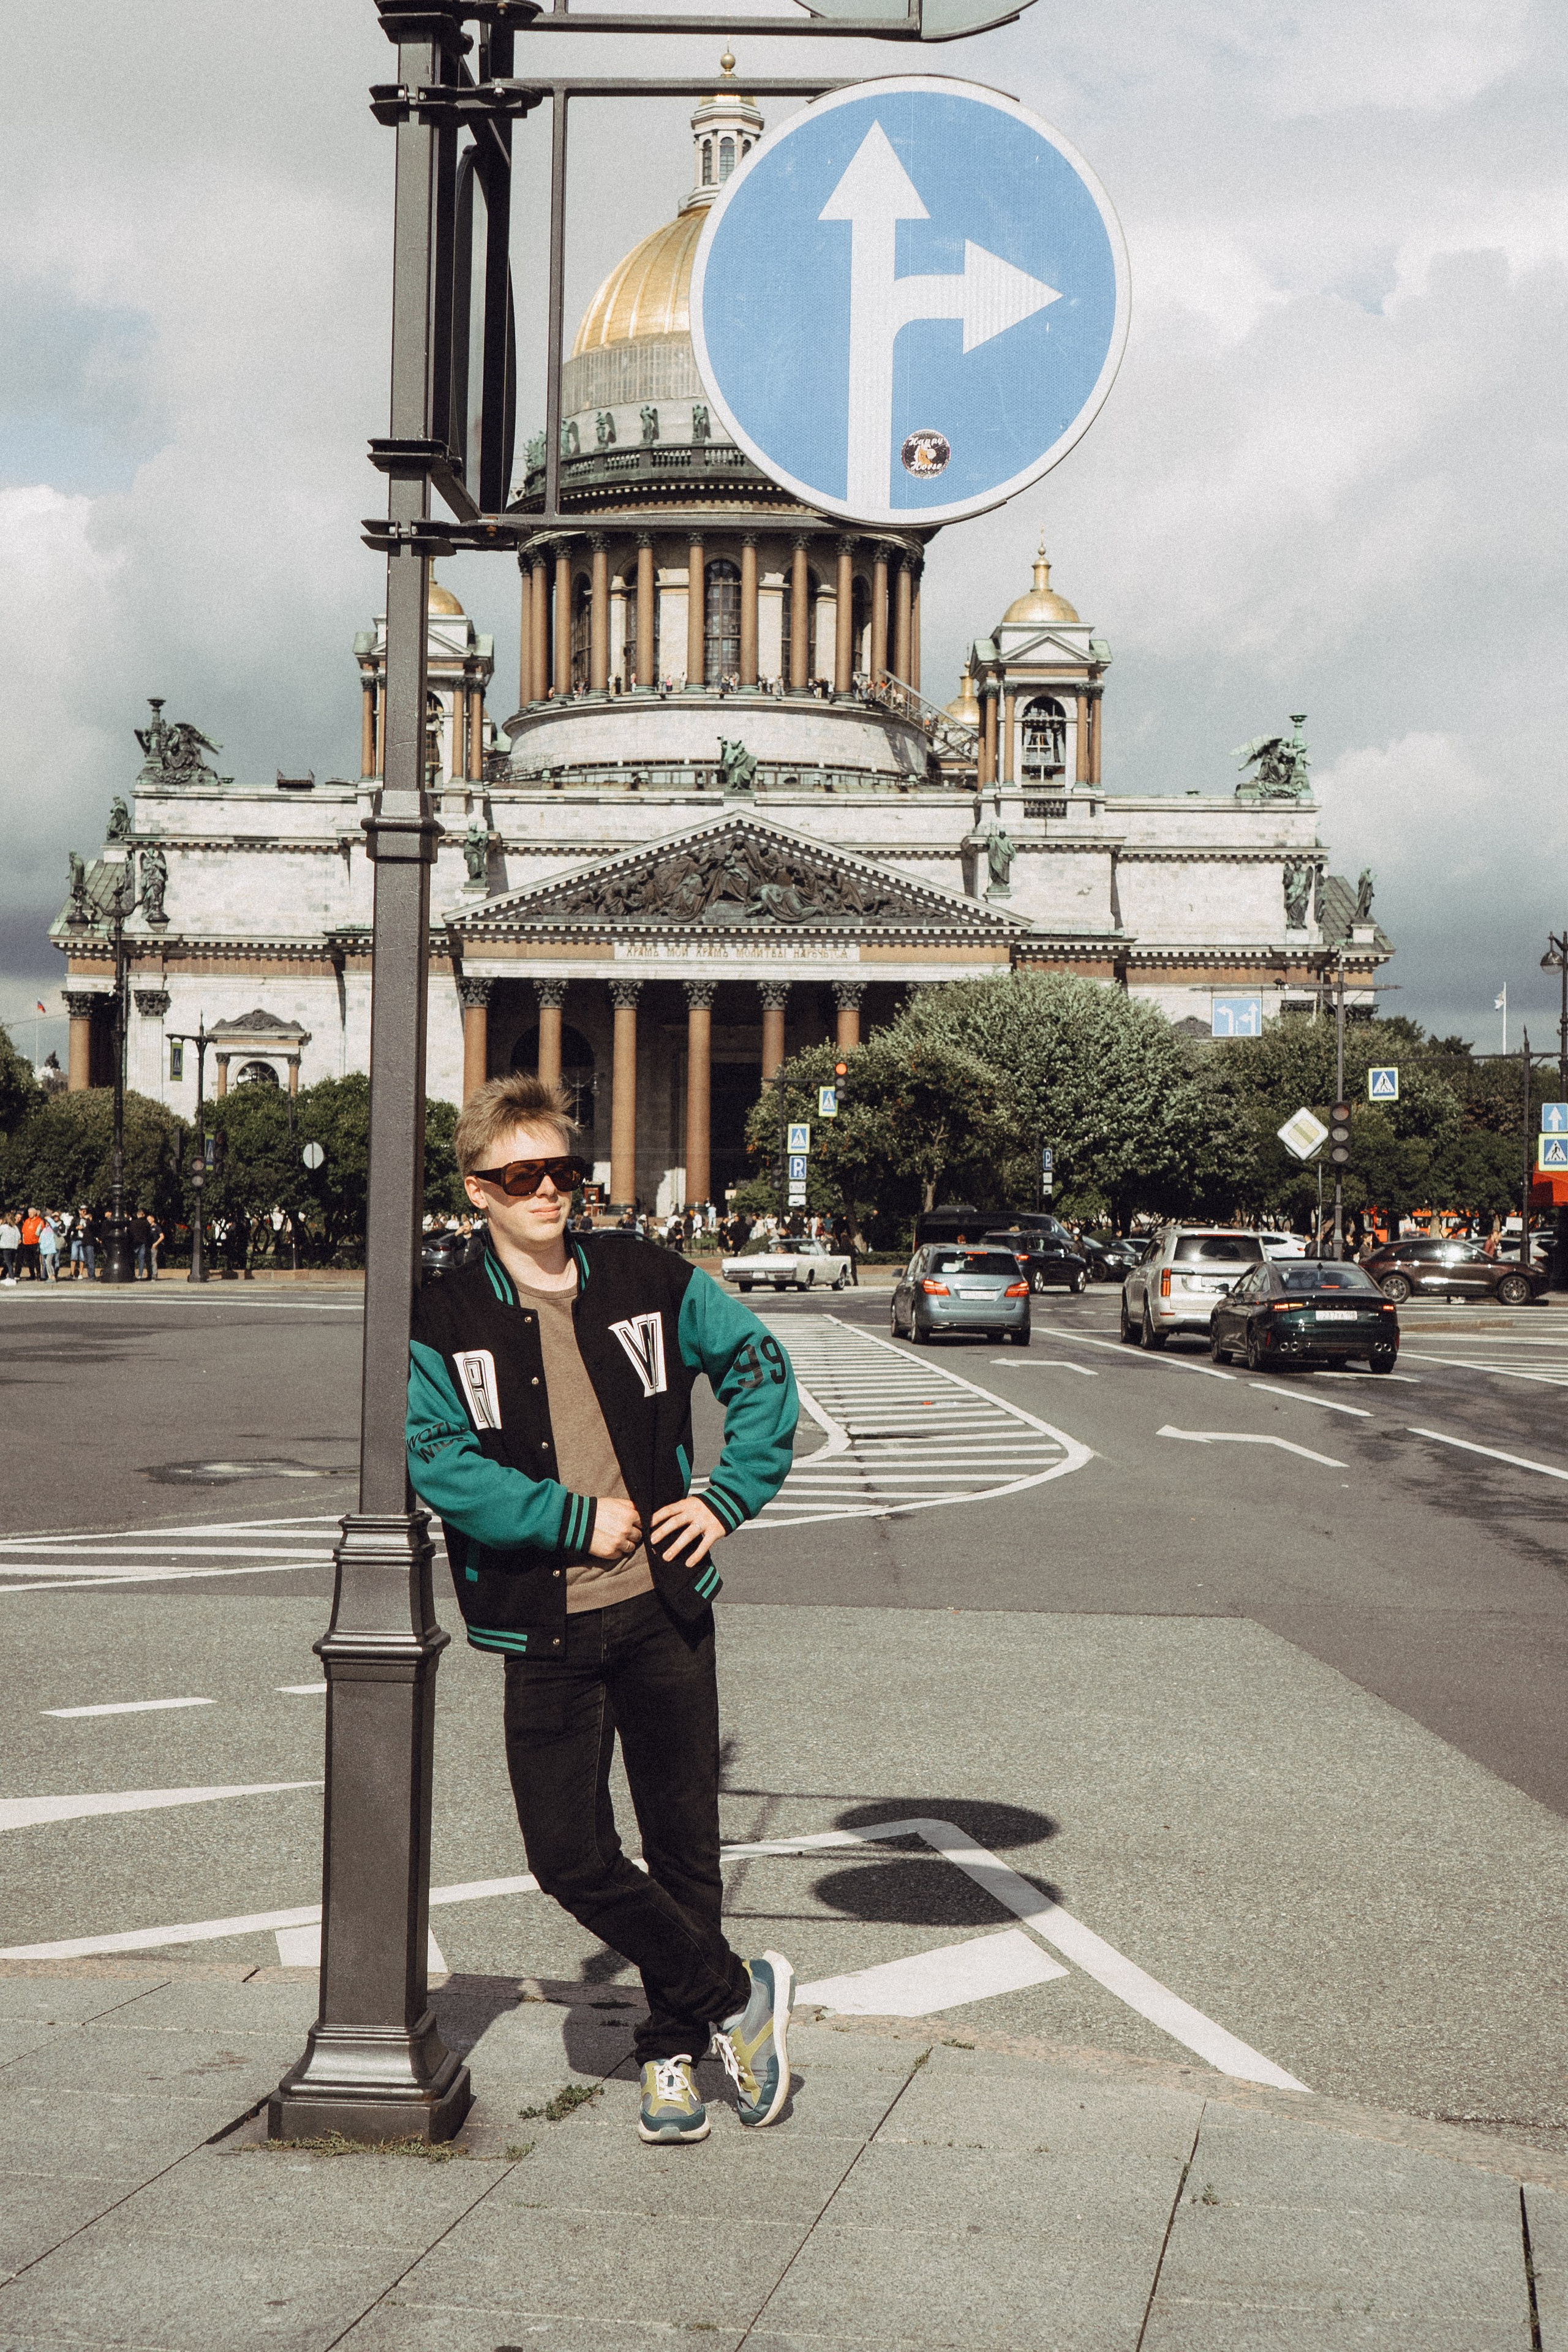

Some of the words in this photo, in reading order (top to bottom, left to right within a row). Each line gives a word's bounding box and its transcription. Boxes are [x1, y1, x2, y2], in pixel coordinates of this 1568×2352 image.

[908, 437, 943, 447] Happy
[911, 462, 943, 470] Horse
[733, 1335, 786, 1389] 99
